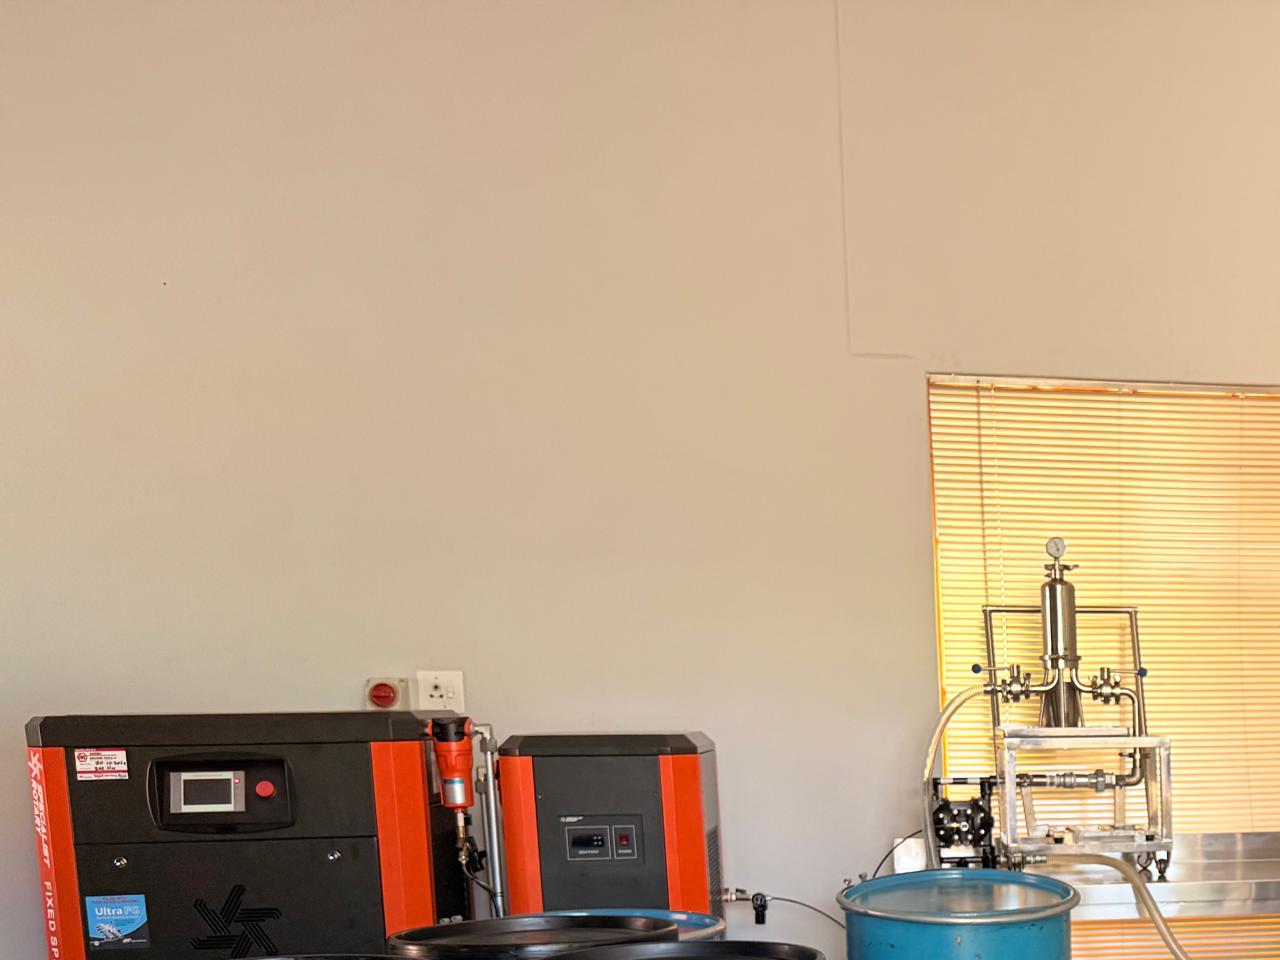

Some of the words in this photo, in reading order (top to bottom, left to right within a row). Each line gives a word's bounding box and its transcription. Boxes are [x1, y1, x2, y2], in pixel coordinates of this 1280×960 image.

[30, 778, 42, 836] ROTARY
[37, 782, 51, 868] SPECIALIST
[44, 881, 56, 932] FIXED
[95, 906, 123, 916] Ultra
